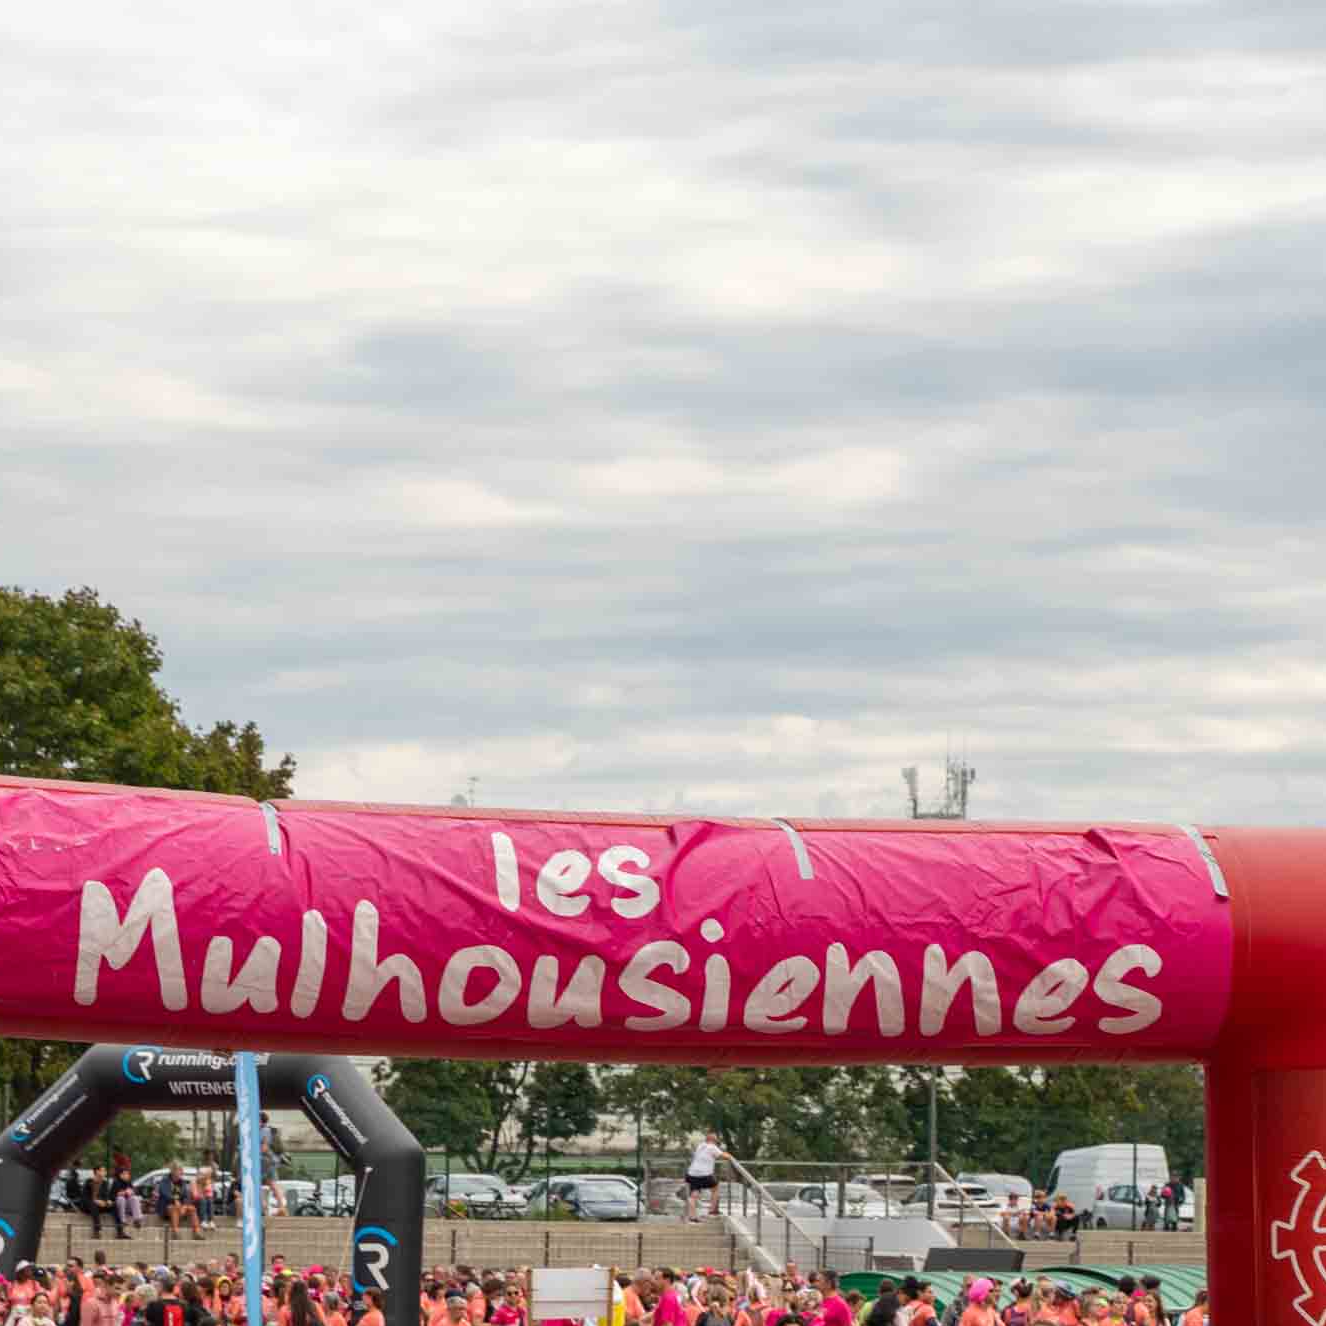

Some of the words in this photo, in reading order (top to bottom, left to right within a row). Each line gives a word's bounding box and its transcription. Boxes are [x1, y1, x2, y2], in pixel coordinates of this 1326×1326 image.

[491, 831, 661, 919] les
[72, 867, 1164, 1037] Mulhousiennes
[168, 1080, 237, 1096] WITTENHE
